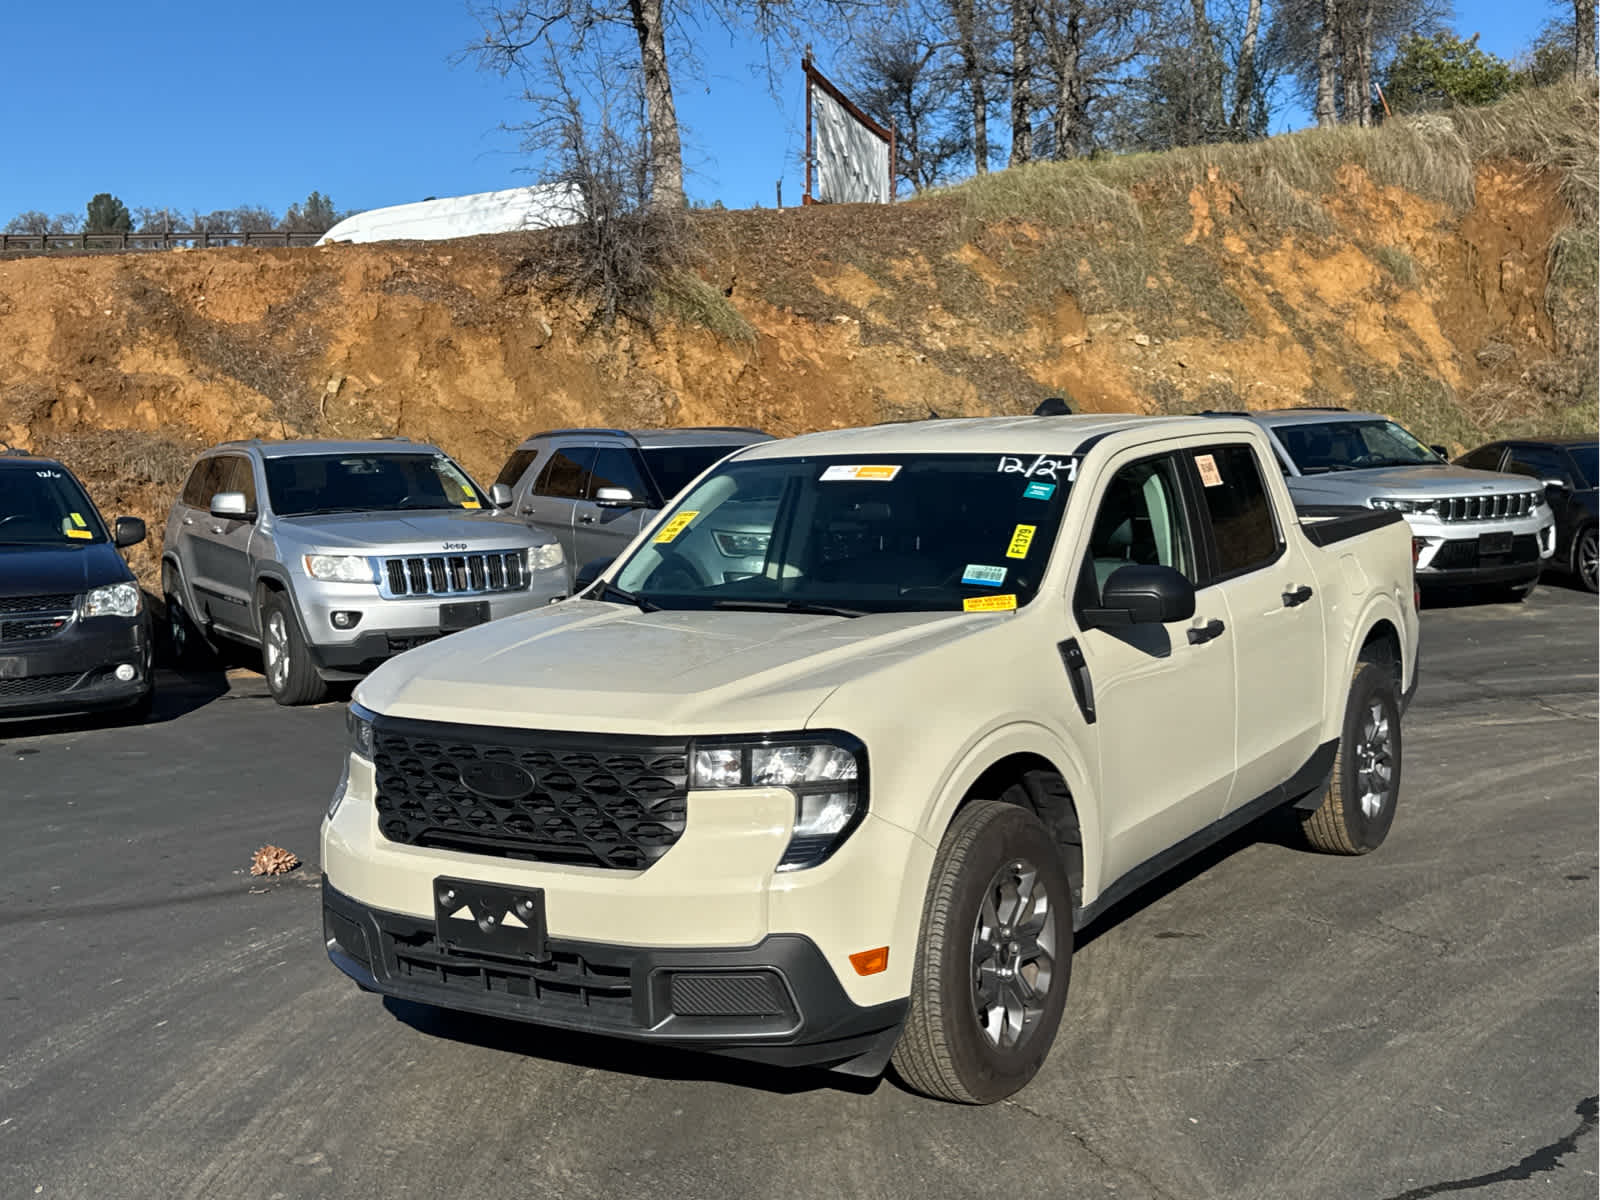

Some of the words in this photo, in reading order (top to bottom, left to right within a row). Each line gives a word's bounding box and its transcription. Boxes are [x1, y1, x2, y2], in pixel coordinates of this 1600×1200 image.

[997, 454, 1078, 481] 12/24
[442, 541, 468, 550] Jeep
[1010, 528, 1032, 555] F1379
